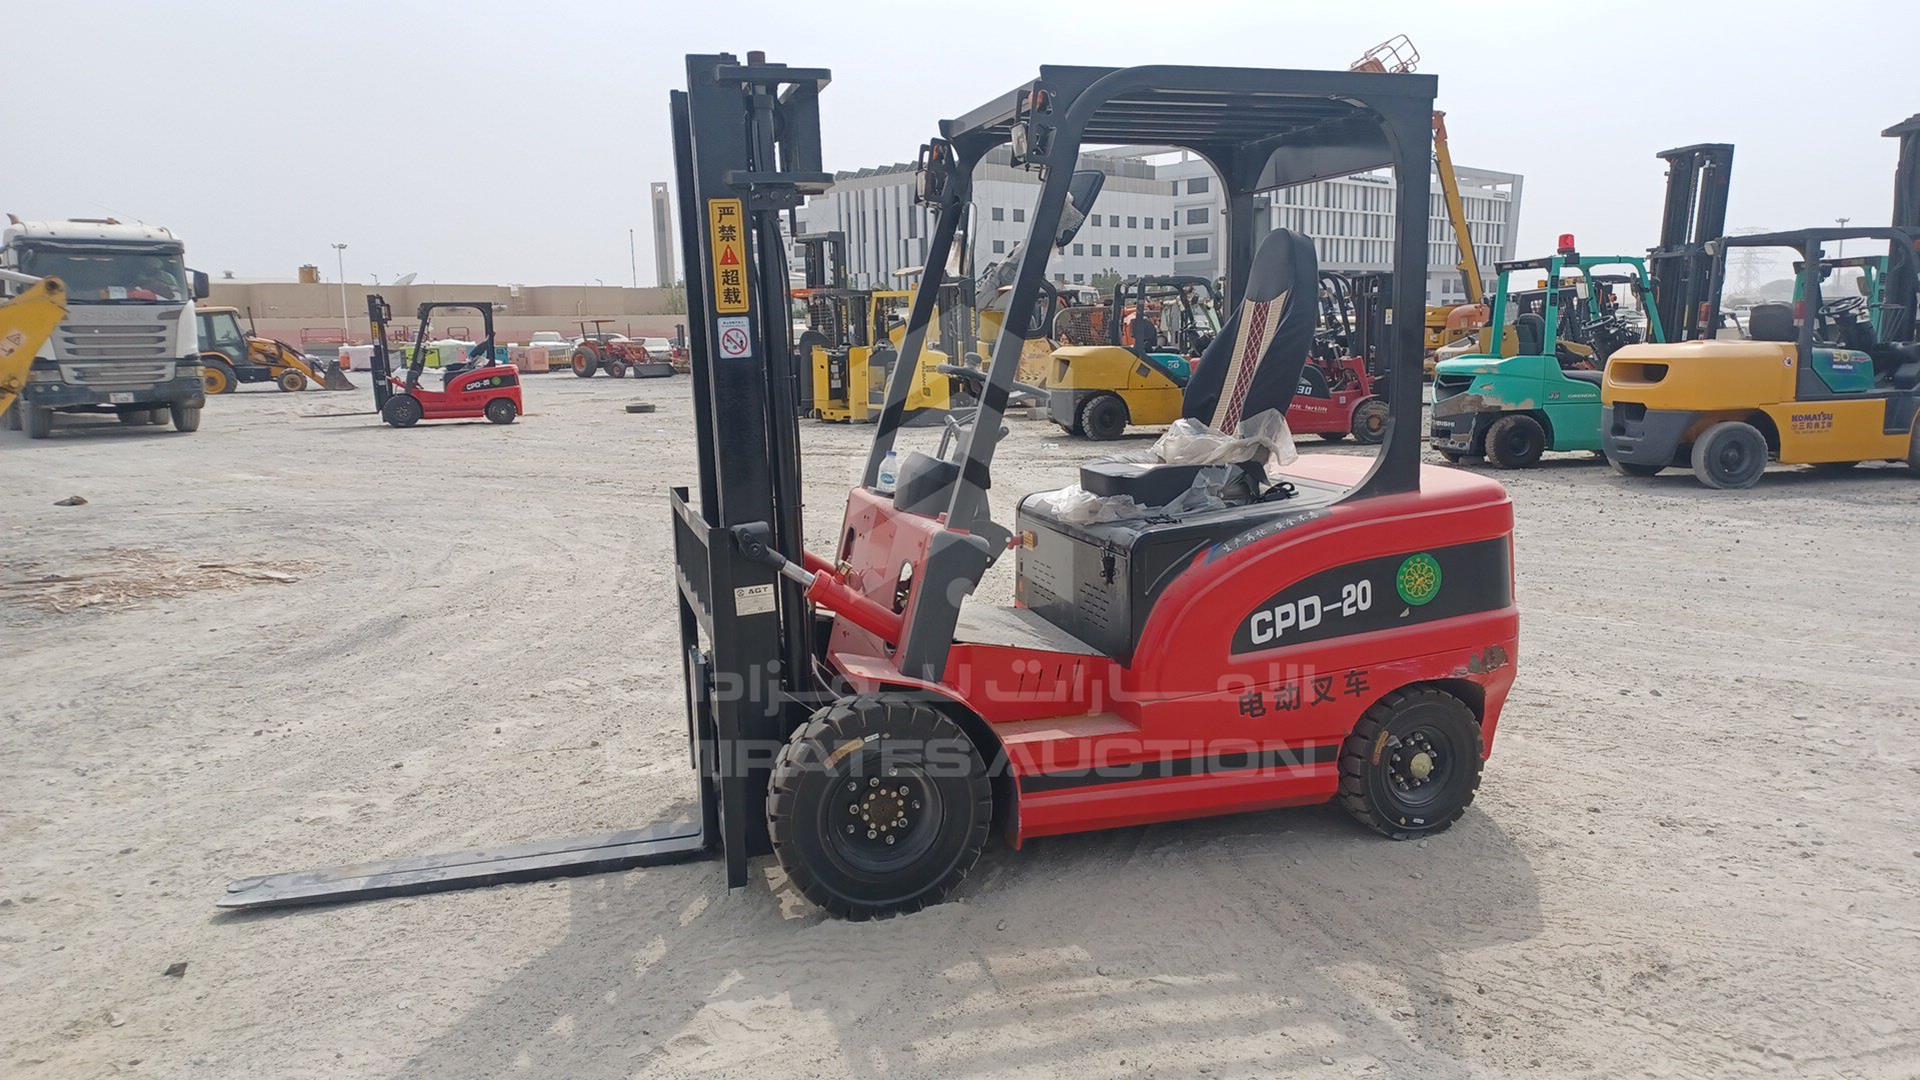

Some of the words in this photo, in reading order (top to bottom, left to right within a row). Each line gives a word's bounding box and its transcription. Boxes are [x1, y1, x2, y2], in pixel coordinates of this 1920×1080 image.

[717, 206, 737, 242] 严禁
[721, 269, 742, 304] 超载
[1296, 385, 1312, 395] 30
[1791, 411, 1833, 423] KOMATSU
[1250, 579, 1372, 645] CPD-20
[1238, 670, 1370, 718] 电动叉车
